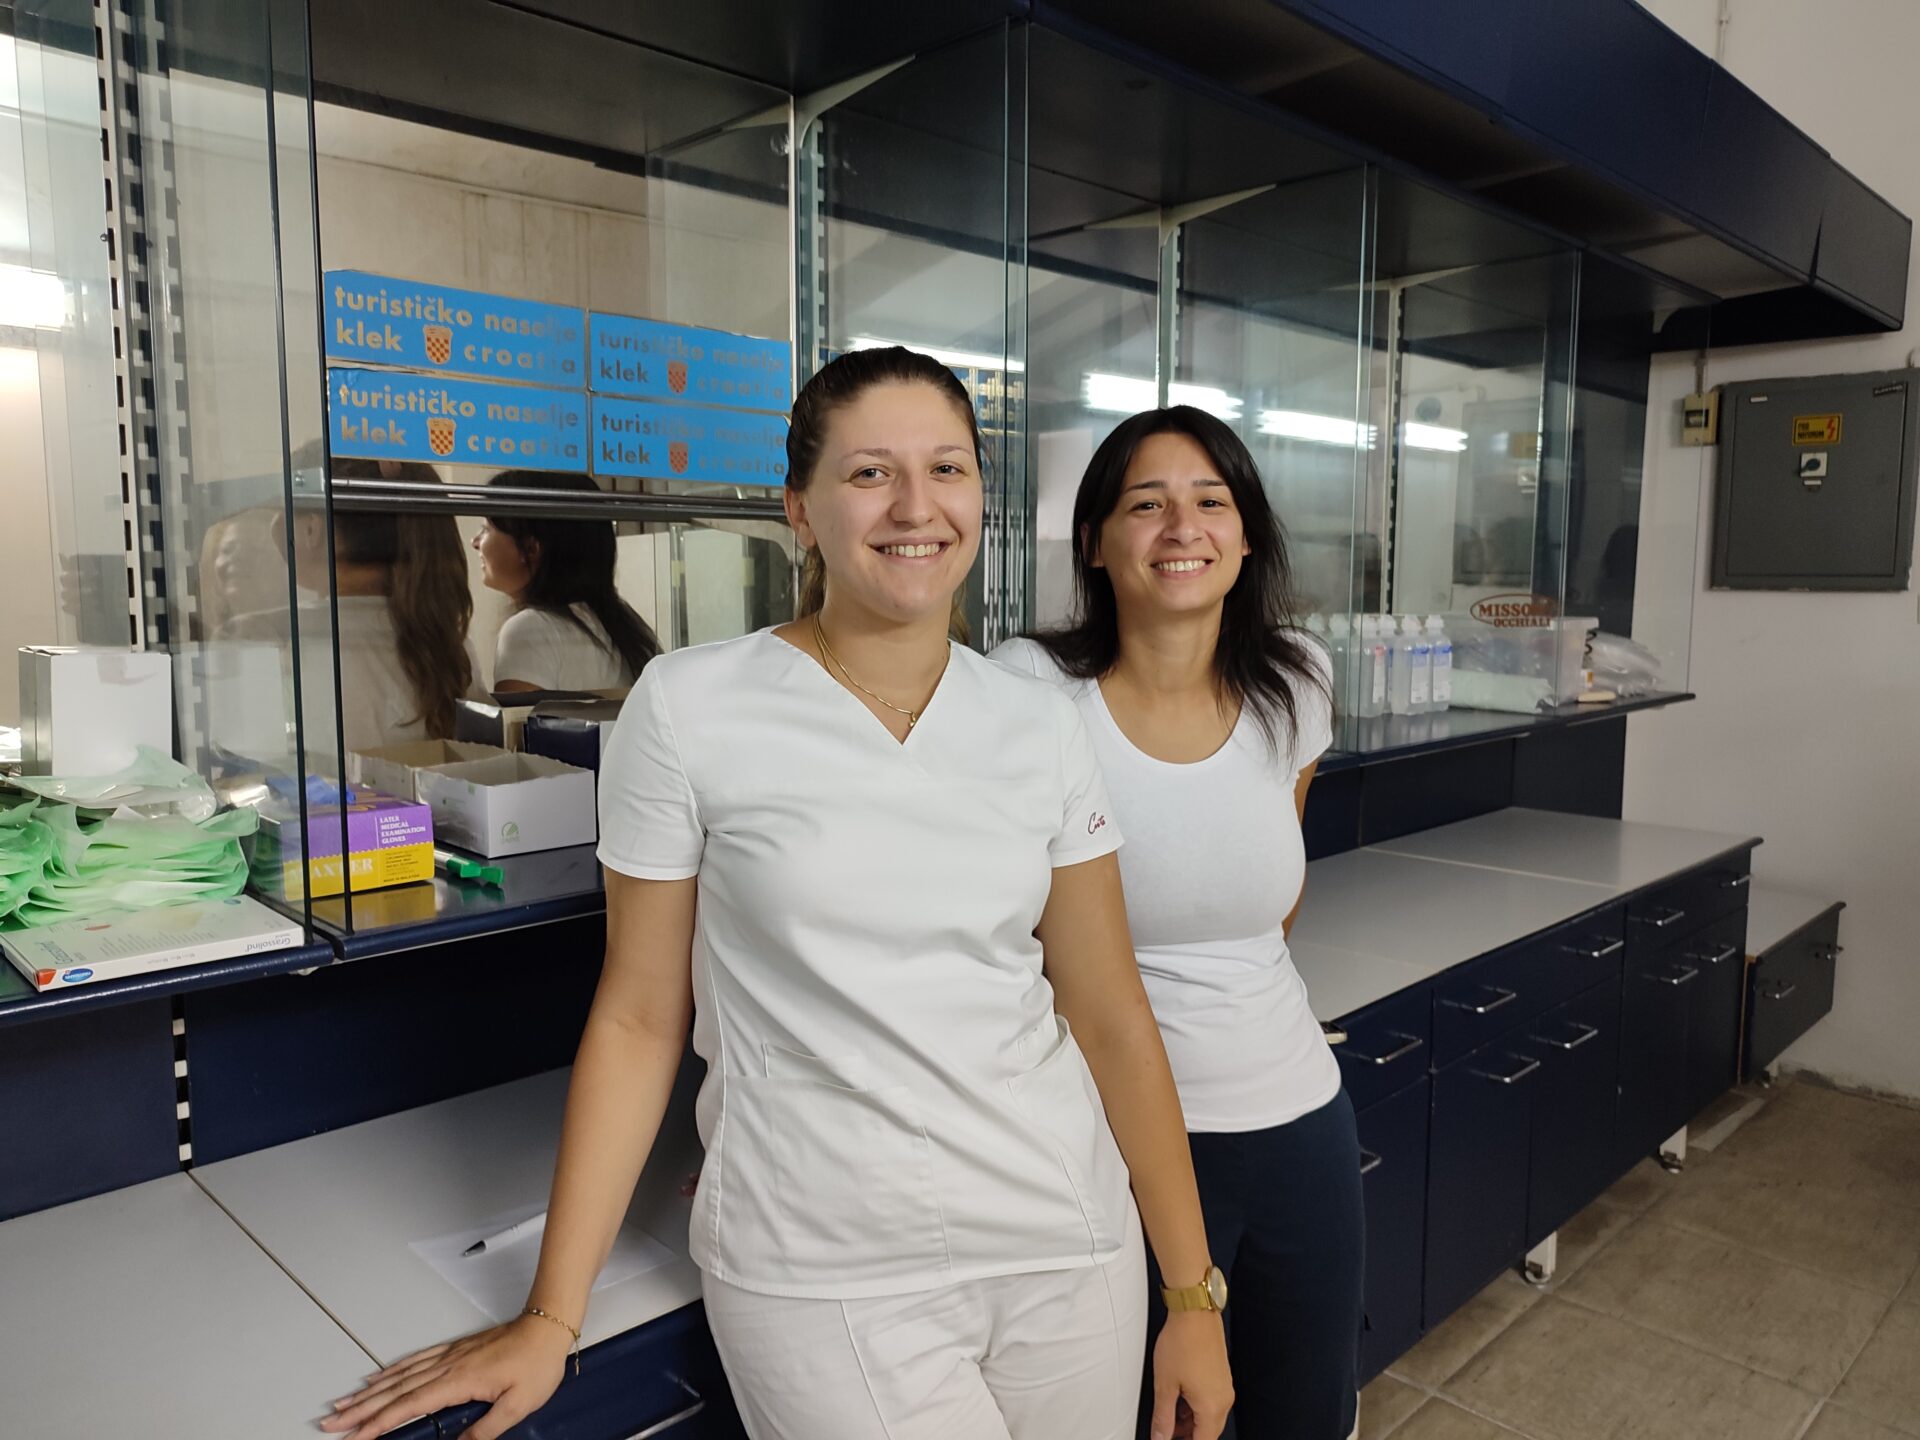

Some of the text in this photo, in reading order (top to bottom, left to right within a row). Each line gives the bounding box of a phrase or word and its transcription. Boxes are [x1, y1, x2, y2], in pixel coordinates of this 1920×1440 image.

[334, 286, 473, 327] turističko
[336, 318, 404, 351] klek
[600, 358, 649, 383] klek
[339, 383, 476, 417] turističko
[341, 416, 407, 446] klek
[602, 441, 650, 465] klek
[1478, 603, 1554, 617] MISSO
[381, 821, 409, 830] MEDICAL
[246, 936, 291, 952] Grassolind
